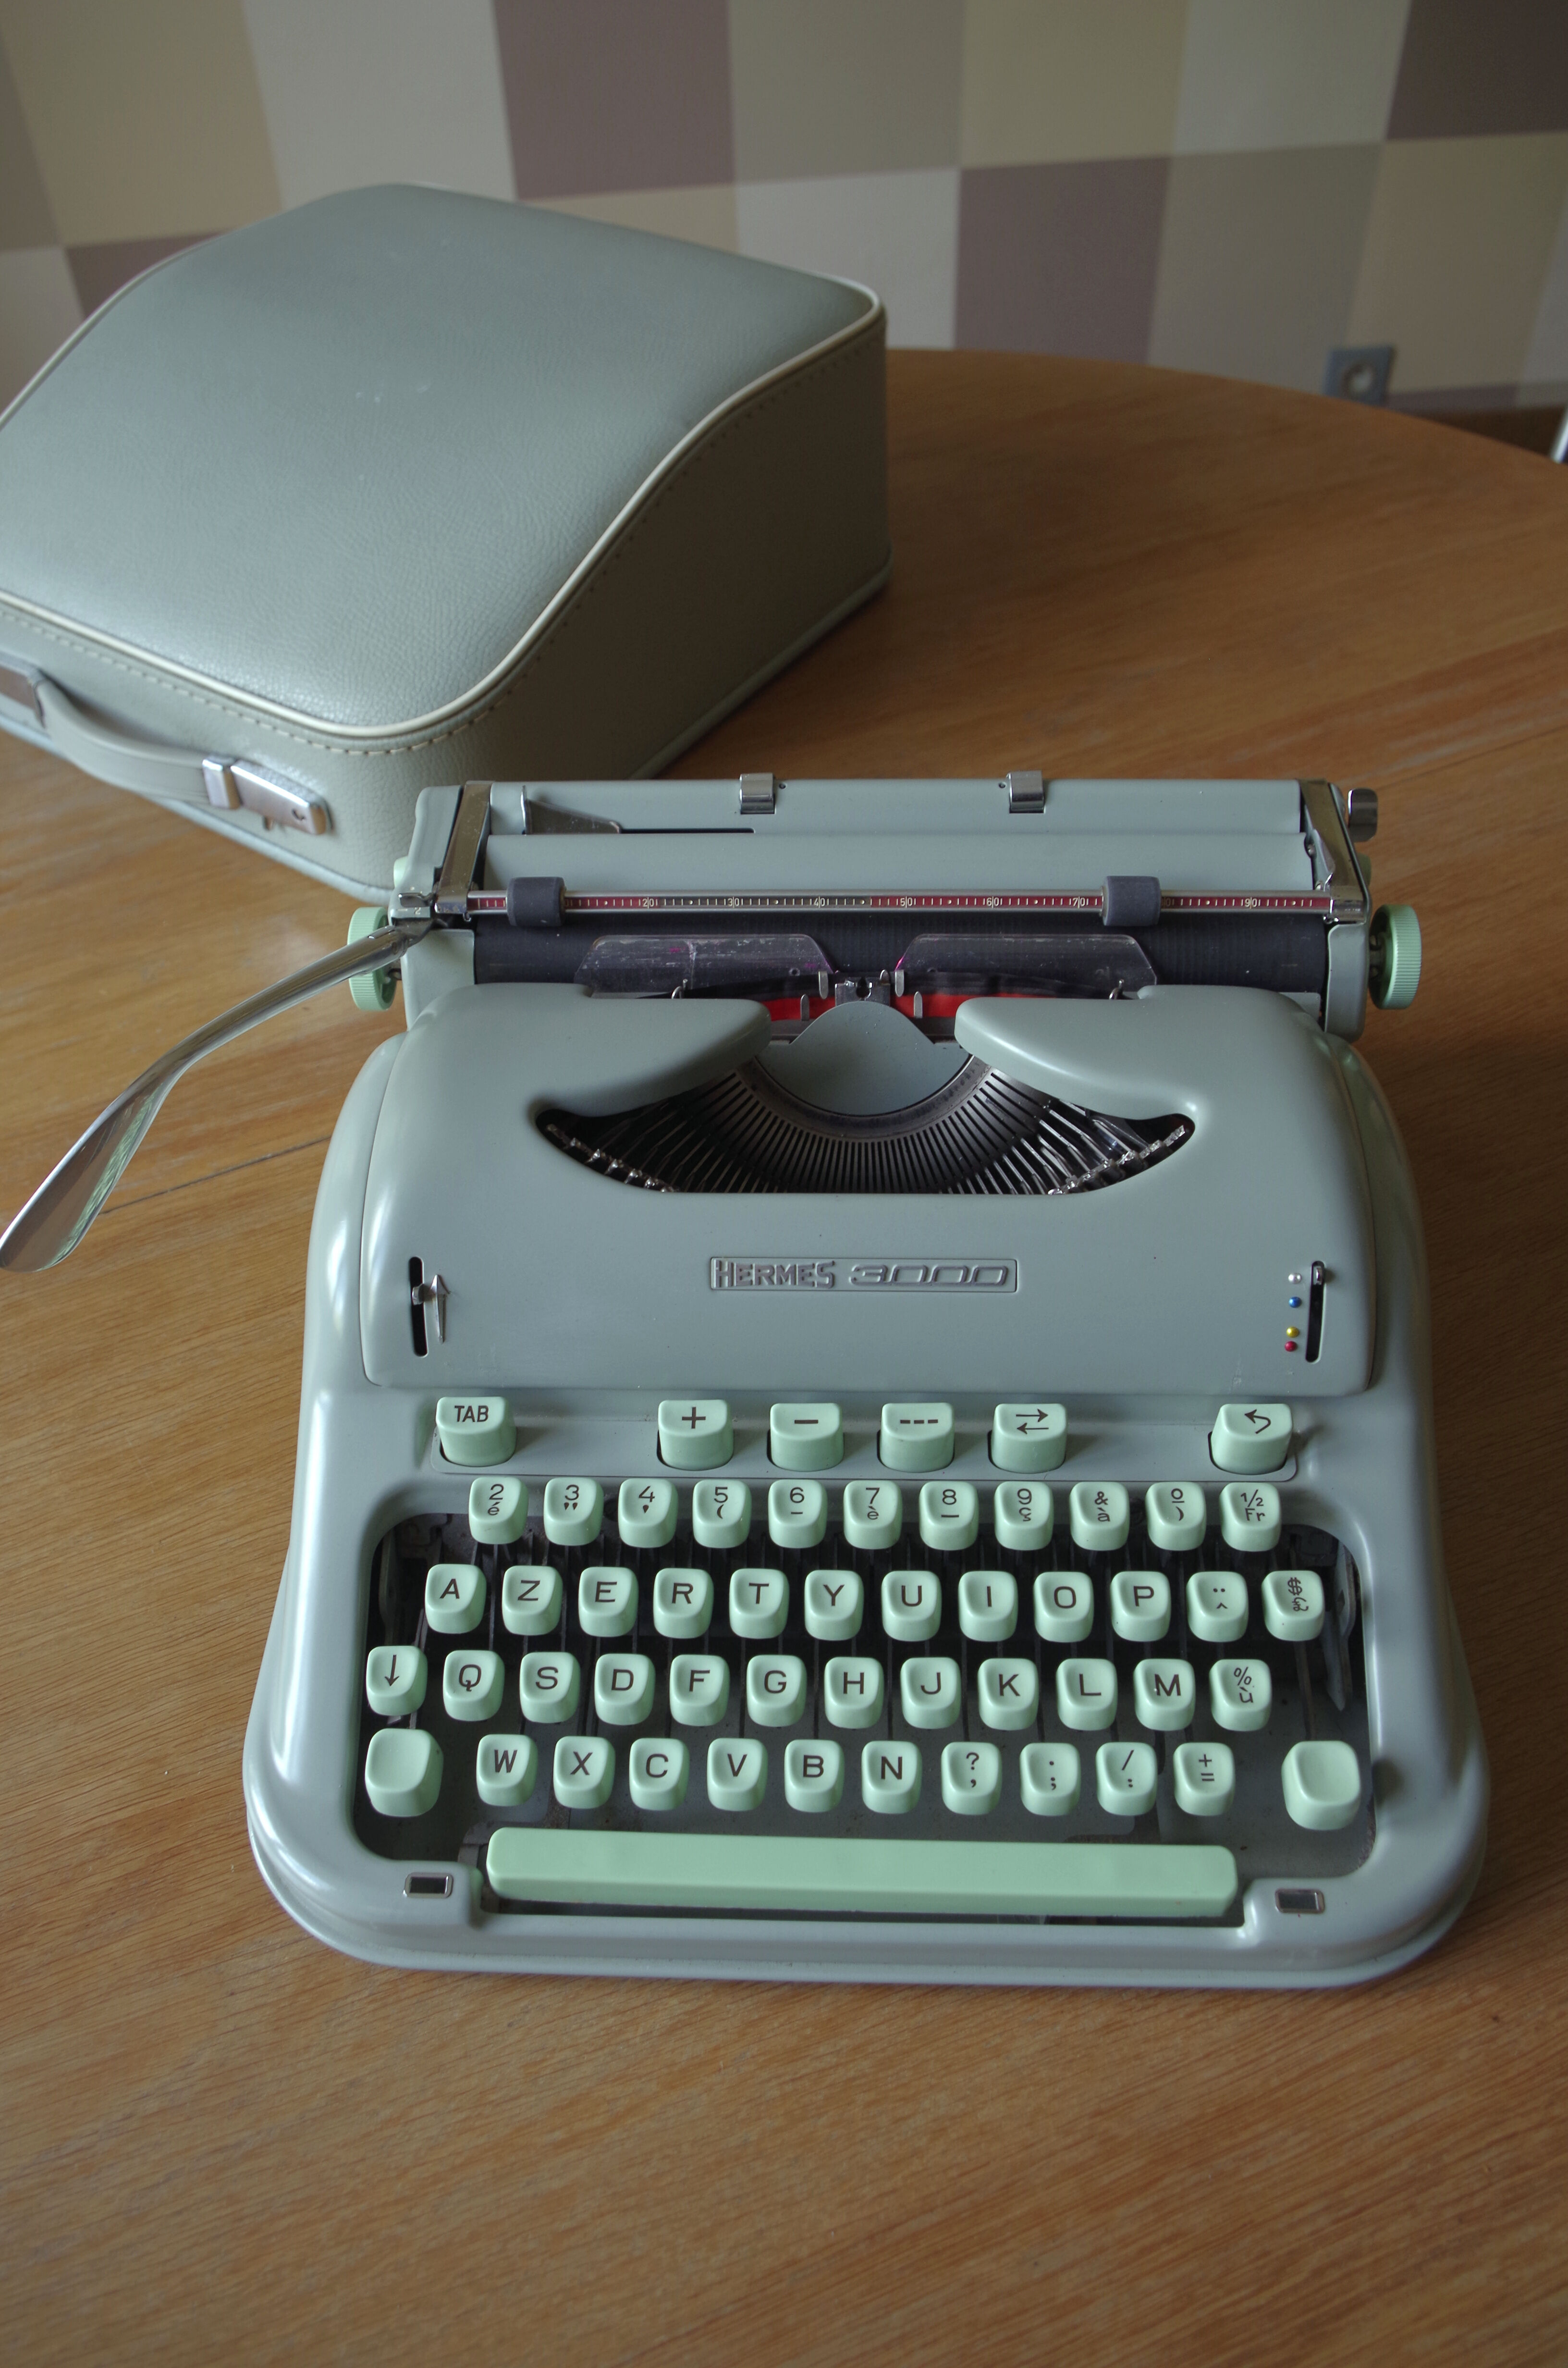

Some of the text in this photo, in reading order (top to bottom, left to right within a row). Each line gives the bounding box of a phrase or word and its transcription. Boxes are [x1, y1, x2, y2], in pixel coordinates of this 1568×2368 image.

[642, 898, 654, 907] 20
[727, 898, 740, 907] 30
[814, 898, 826, 907] 40
[900, 898, 913, 907] 50
[986, 898, 999, 907] 60
[1073, 898, 1085, 907] 70
[1244, 898, 1257, 907] 90
[712, 1259, 1008, 1289] HERMES 3000
[454, 1405, 489, 1422] TAB
[681, 1406, 706, 1429] +
[489, 1483, 504, 1500] 2
[564, 1484, 579, 1501] 3
[638, 1486, 655, 1503] 4
[713, 1486, 728, 1504] 5
[790, 1487, 805, 1504] 6
[866, 1487, 880, 1505] 7
[942, 1489, 957, 1505] 8
[1017, 1488, 1032, 1505] 9
[1094, 1491, 1108, 1505] &
[487, 1501, 501, 1516] é
[716, 1504, 724, 1519] (
[867, 1505, 879, 1520] è
[1018, 1507, 1031, 1522] ç
[1097, 1507, 1111, 1522] à
[1176, 1506, 1184, 1521] )
[1245, 1507, 1265, 1522] Fr
[440, 1578, 460, 1599] A
[517, 1579, 540, 1602] Z
[595, 1581, 617, 1603] E
[672, 1582, 694, 1604] R
[748, 1582, 770, 1604] T
[823, 1584, 845, 1606] Y
[901, 1585, 922, 1607] U
[986, 1586, 992, 1607] I
[1133, 1586, 1154, 1607] P
[1287, 1577, 1303, 1596] $
[1054, 1586, 1077, 1609] O
[1291, 1597, 1309, 1612] £
[458, 1664, 482, 1692] Q
[535, 1666, 559, 1690] S
[611, 1668, 634, 1691] D
[689, 1669, 710, 1692] F
[764, 1670, 787, 1694] G
[843, 1672, 865, 1695] H
[920, 1672, 942, 1695] J
[999, 1674, 1020, 1697] K
[1079, 1673, 1102, 1697] L
[1154, 1674, 1181, 1697] M
[1233, 1666, 1252, 1686] %
[1239, 1686, 1254, 1703] ù
[494, 1750, 518, 1773] W
[570, 1751, 593, 1776] X
[646, 1753, 669, 1778] C
[727, 1753, 747, 1777] V
[803, 1754, 824, 1778] B
[881, 1756, 903, 1780] N
[966, 1751, 980, 1770] ?
[1121, 1750, 1134, 1771] /
[1198, 1754, 1213, 1767] +
[1050, 1777, 1057, 1790] ;
[1200, 1773, 1215, 1782] =
